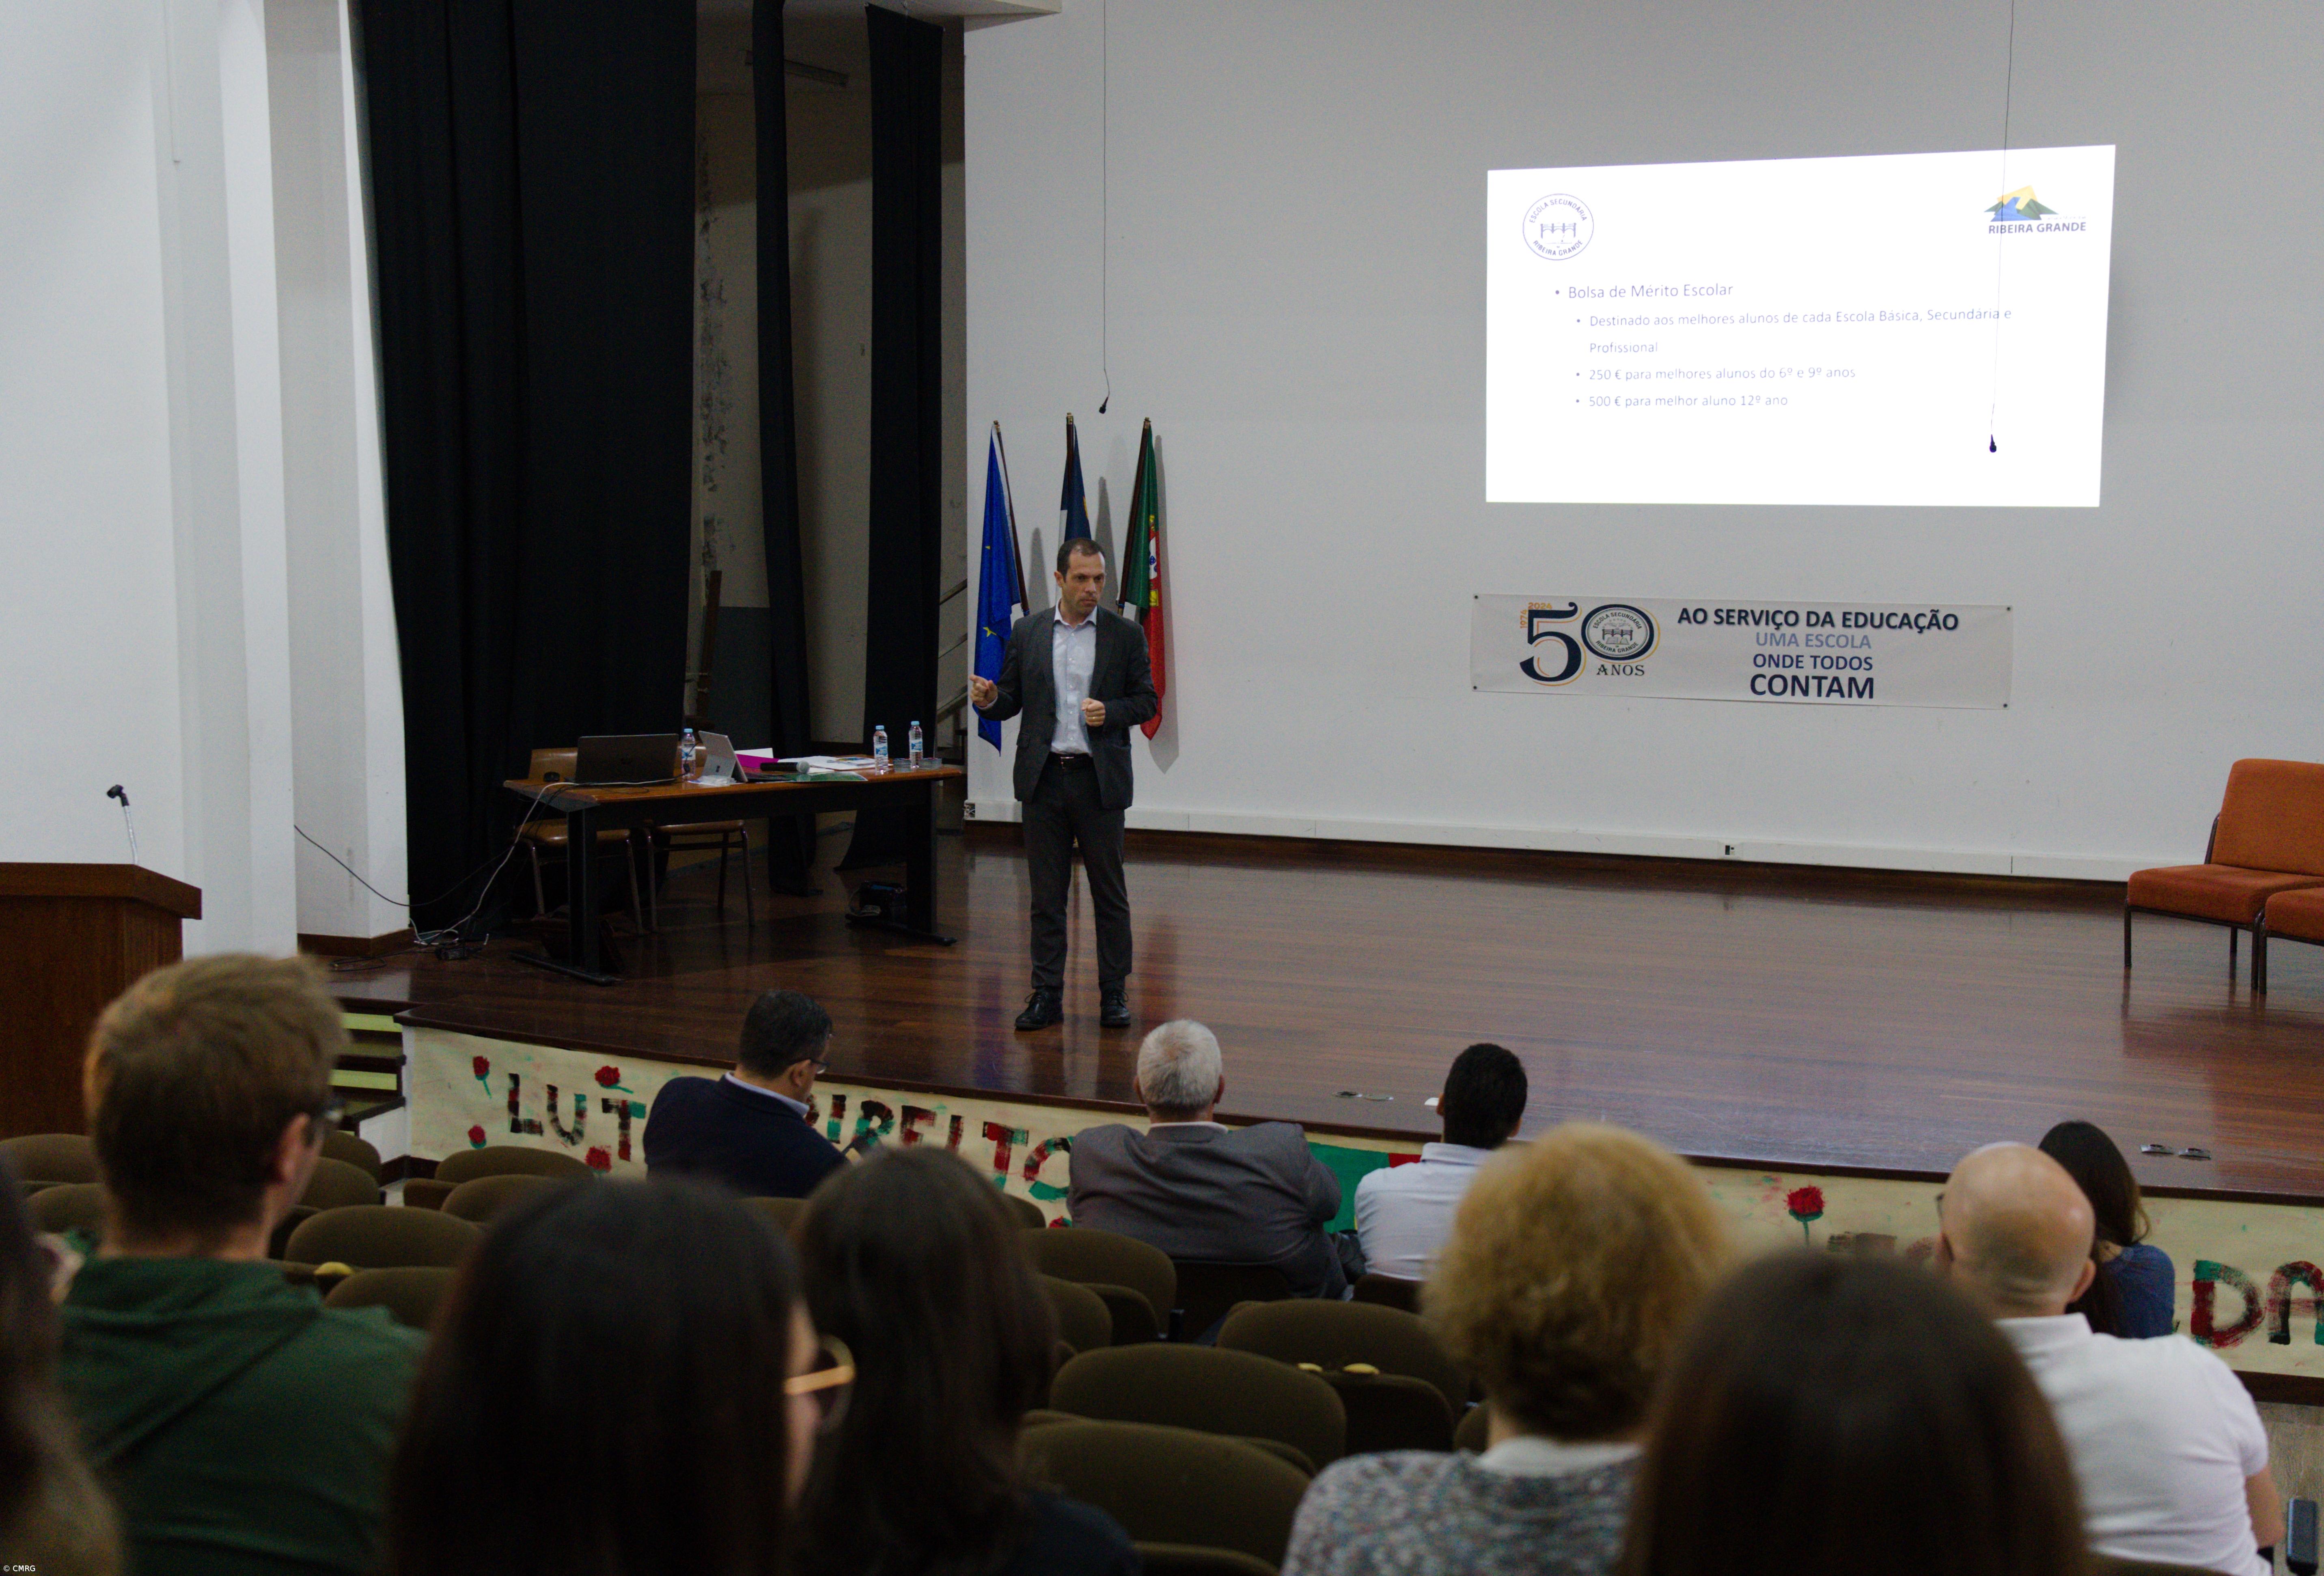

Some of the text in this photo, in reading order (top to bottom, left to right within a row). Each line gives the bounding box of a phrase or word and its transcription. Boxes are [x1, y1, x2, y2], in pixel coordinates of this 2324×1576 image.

[1529, 202, 1549, 223] ESCOLA
[1988, 222, 2087, 234] RIBEIRA GRANDE
[1533, 239, 1583, 256] RIBEIRA GRANDE
[1569, 283, 1733, 298] Bolsa de Mérito Escolar
[1590, 308, 2011, 326] Destinado aos melhores alunos de cada Escola Básica, Secundária e
[1590, 342, 1658, 353] Profissional
[1589, 367, 1856, 381] 250 € para melhores alunos do 6º e 9º anos
[1589, 395, 1788, 408] 500 € para melhor aluno 12º ano
[1520, 609, 1528, 629] 1974
[1593, 614, 1610, 629] ESCOLA
[1677, 607, 1959, 634] AO SERVIÇO DA EDUCAÇÃO
[1595, 640, 1639, 653] RIBEIRA GRANDE
[1756, 632, 1872, 649] UMA ESCOLA
[1596, 664, 1645, 676] ANOS
[1753, 653, 1873, 671] ONDE TODOS
[1750, 673, 1874, 700] CONTAM
